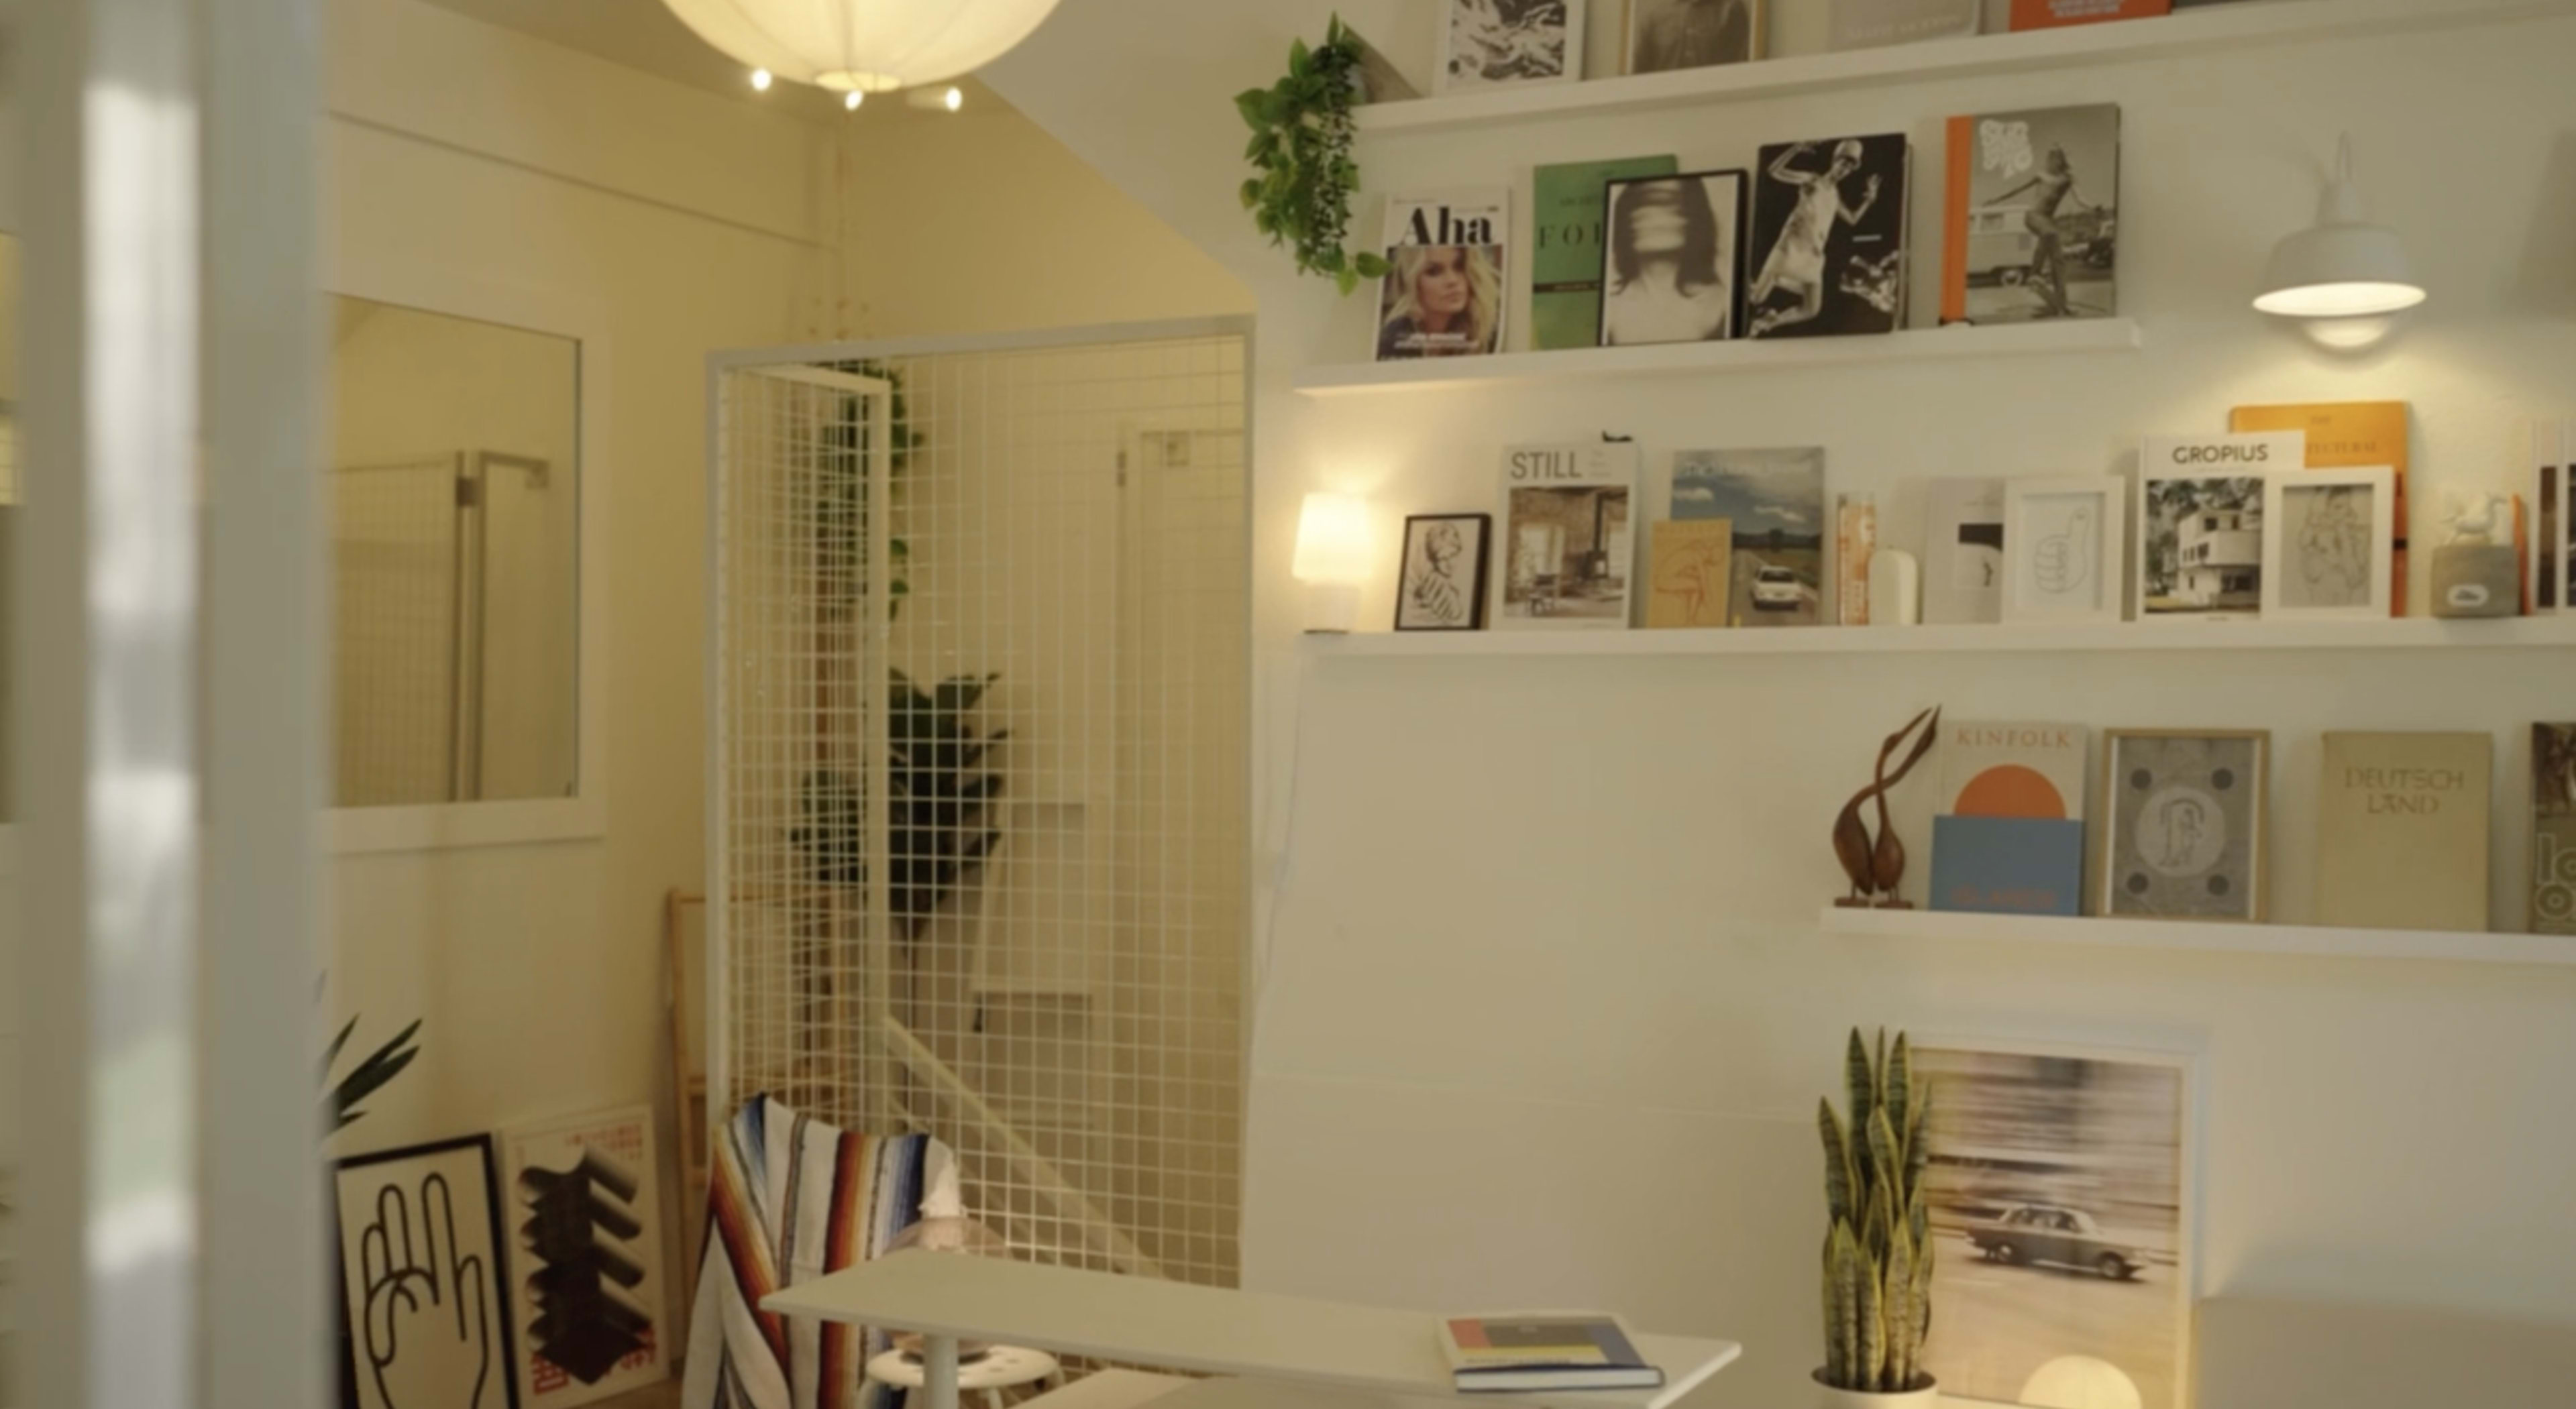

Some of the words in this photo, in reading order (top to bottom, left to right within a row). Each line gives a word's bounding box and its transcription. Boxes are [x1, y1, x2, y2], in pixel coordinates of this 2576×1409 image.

[1399, 206, 1491, 245] Aha
[2172, 443, 2269, 464] GROPIUS
[1511, 451, 1582, 480] STILL
[1957, 728, 2071, 748] KINFOLK
[2345, 767, 2464, 790] DEUTSCH
[2367, 793, 2442, 815] LAND
